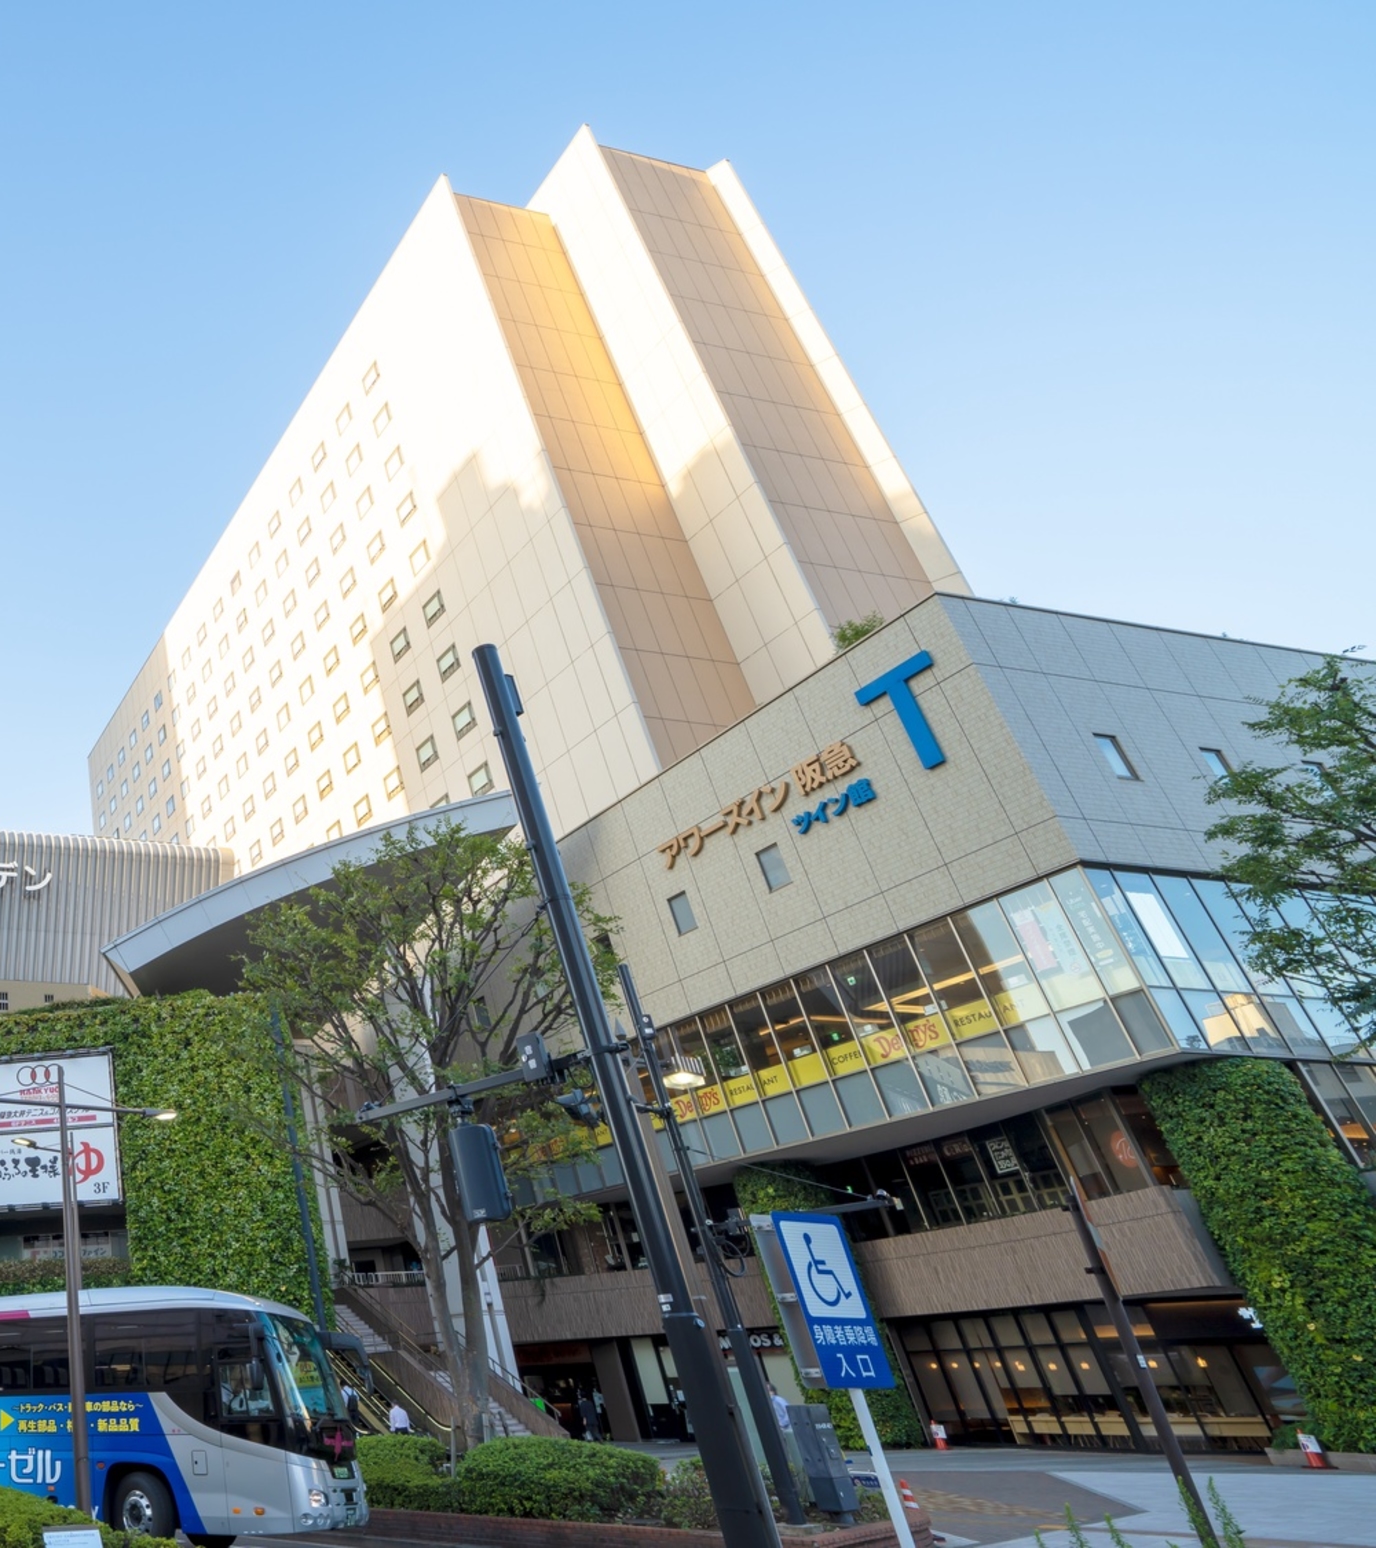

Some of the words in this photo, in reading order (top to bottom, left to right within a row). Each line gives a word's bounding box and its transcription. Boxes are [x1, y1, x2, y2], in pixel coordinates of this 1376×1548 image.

[854, 649, 946, 770] T
[657, 780, 789, 870] アワーズイン
[789, 740, 860, 797] 阪急
[792, 778, 877, 834] ツイン館
[874, 1019, 939, 1059] Deny's
[674, 1087, 720, 1119] Deny's
[93, 1181, 110, 1194] 3F
[813, 1325, 878, 1346] 身障者乗降場
[836, 1353, 876, 1378] 入口
